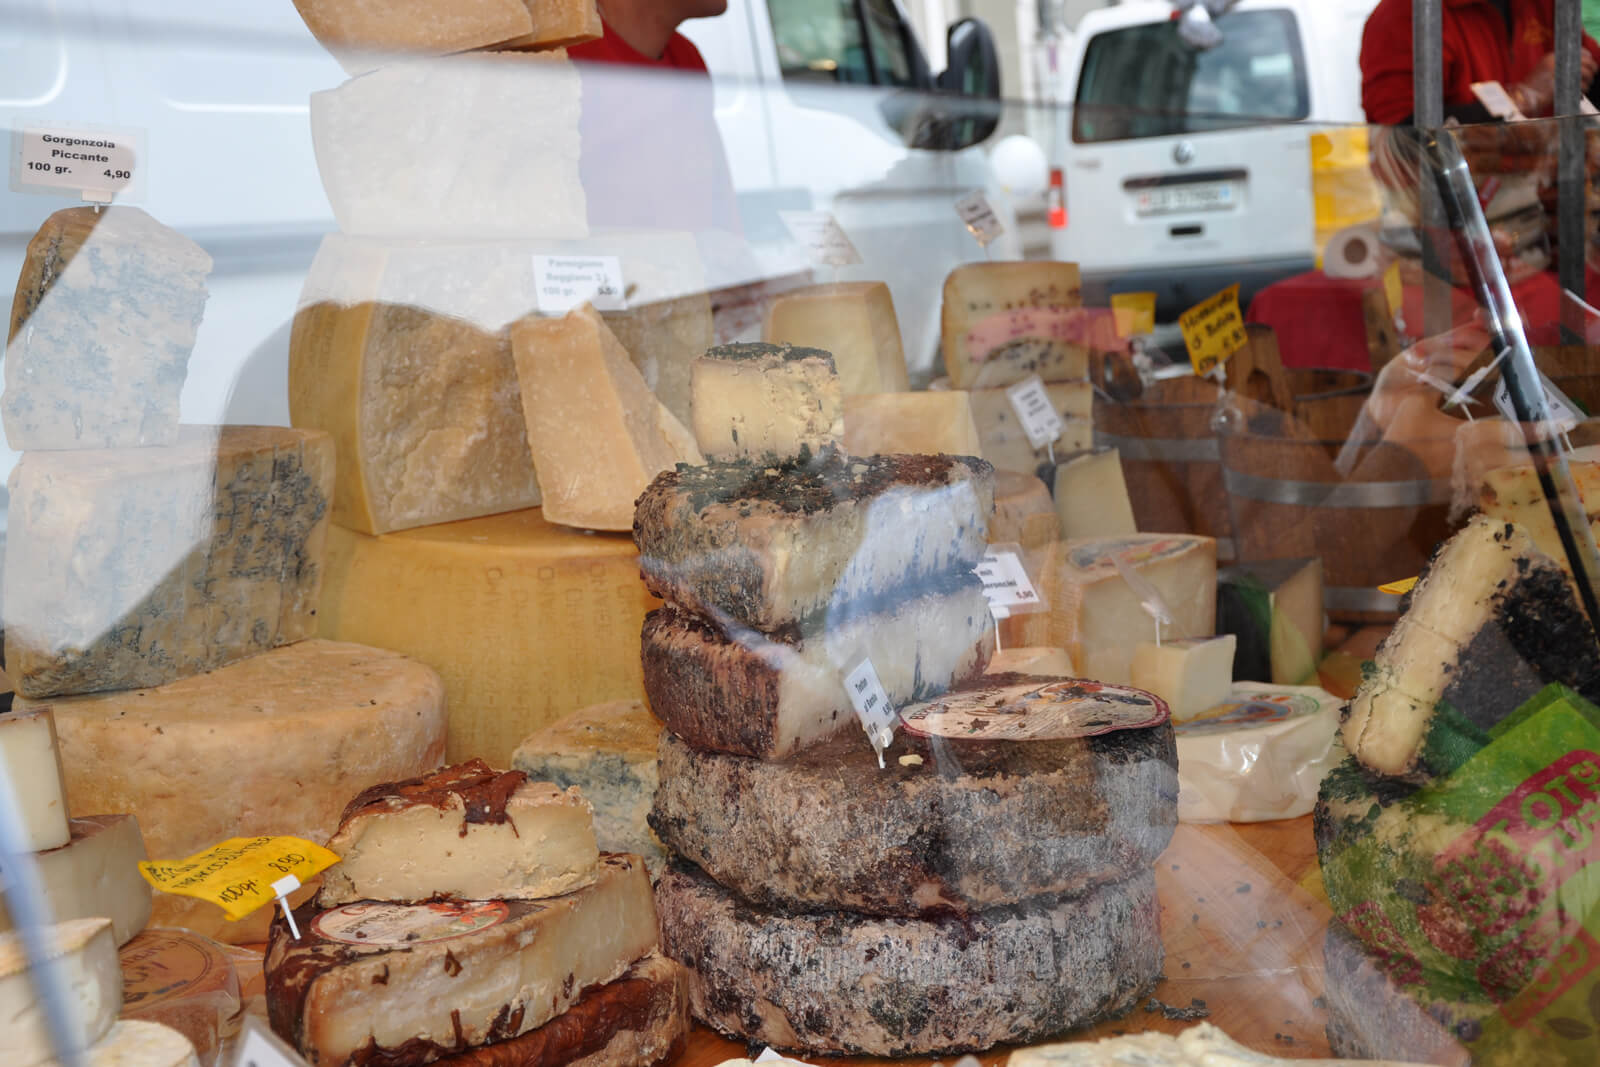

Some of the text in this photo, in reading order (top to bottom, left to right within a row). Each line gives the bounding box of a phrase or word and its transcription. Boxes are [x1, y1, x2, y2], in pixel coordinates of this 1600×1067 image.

[42, 134, 115, 148] Gorgonzola
[51, 149, 108, 162] Piccante
[27, 161, 131, 179] 100 gr. 4,90
